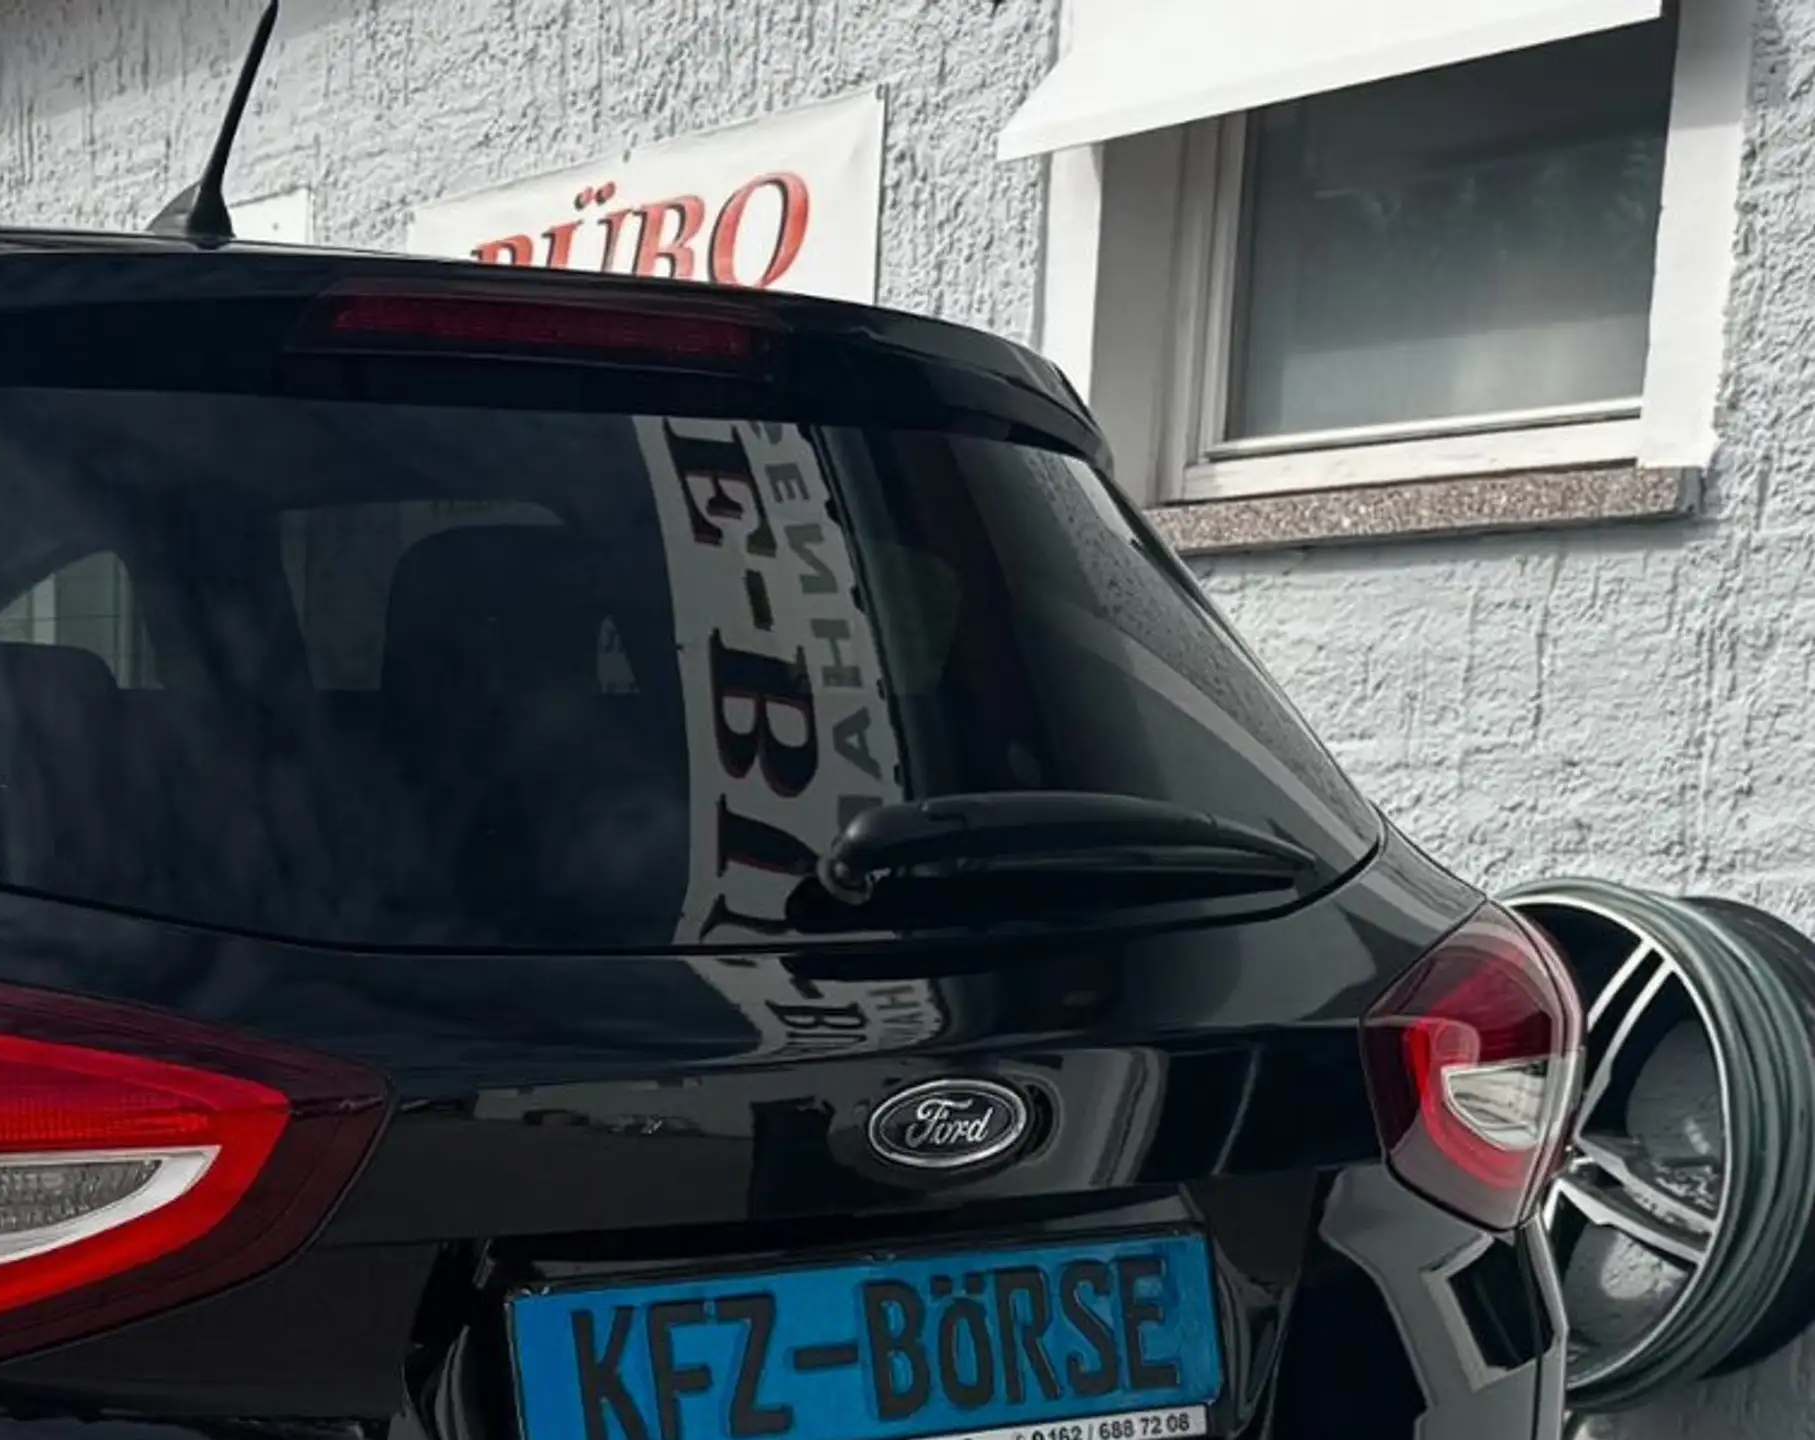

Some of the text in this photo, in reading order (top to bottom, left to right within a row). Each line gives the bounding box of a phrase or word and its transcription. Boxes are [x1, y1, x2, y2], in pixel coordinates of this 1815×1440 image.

[470, 169, 811, 290] ÜRO
[905, 1098, 994, 1147] Ford
[1140, 1415, 1164, 1436] 72
